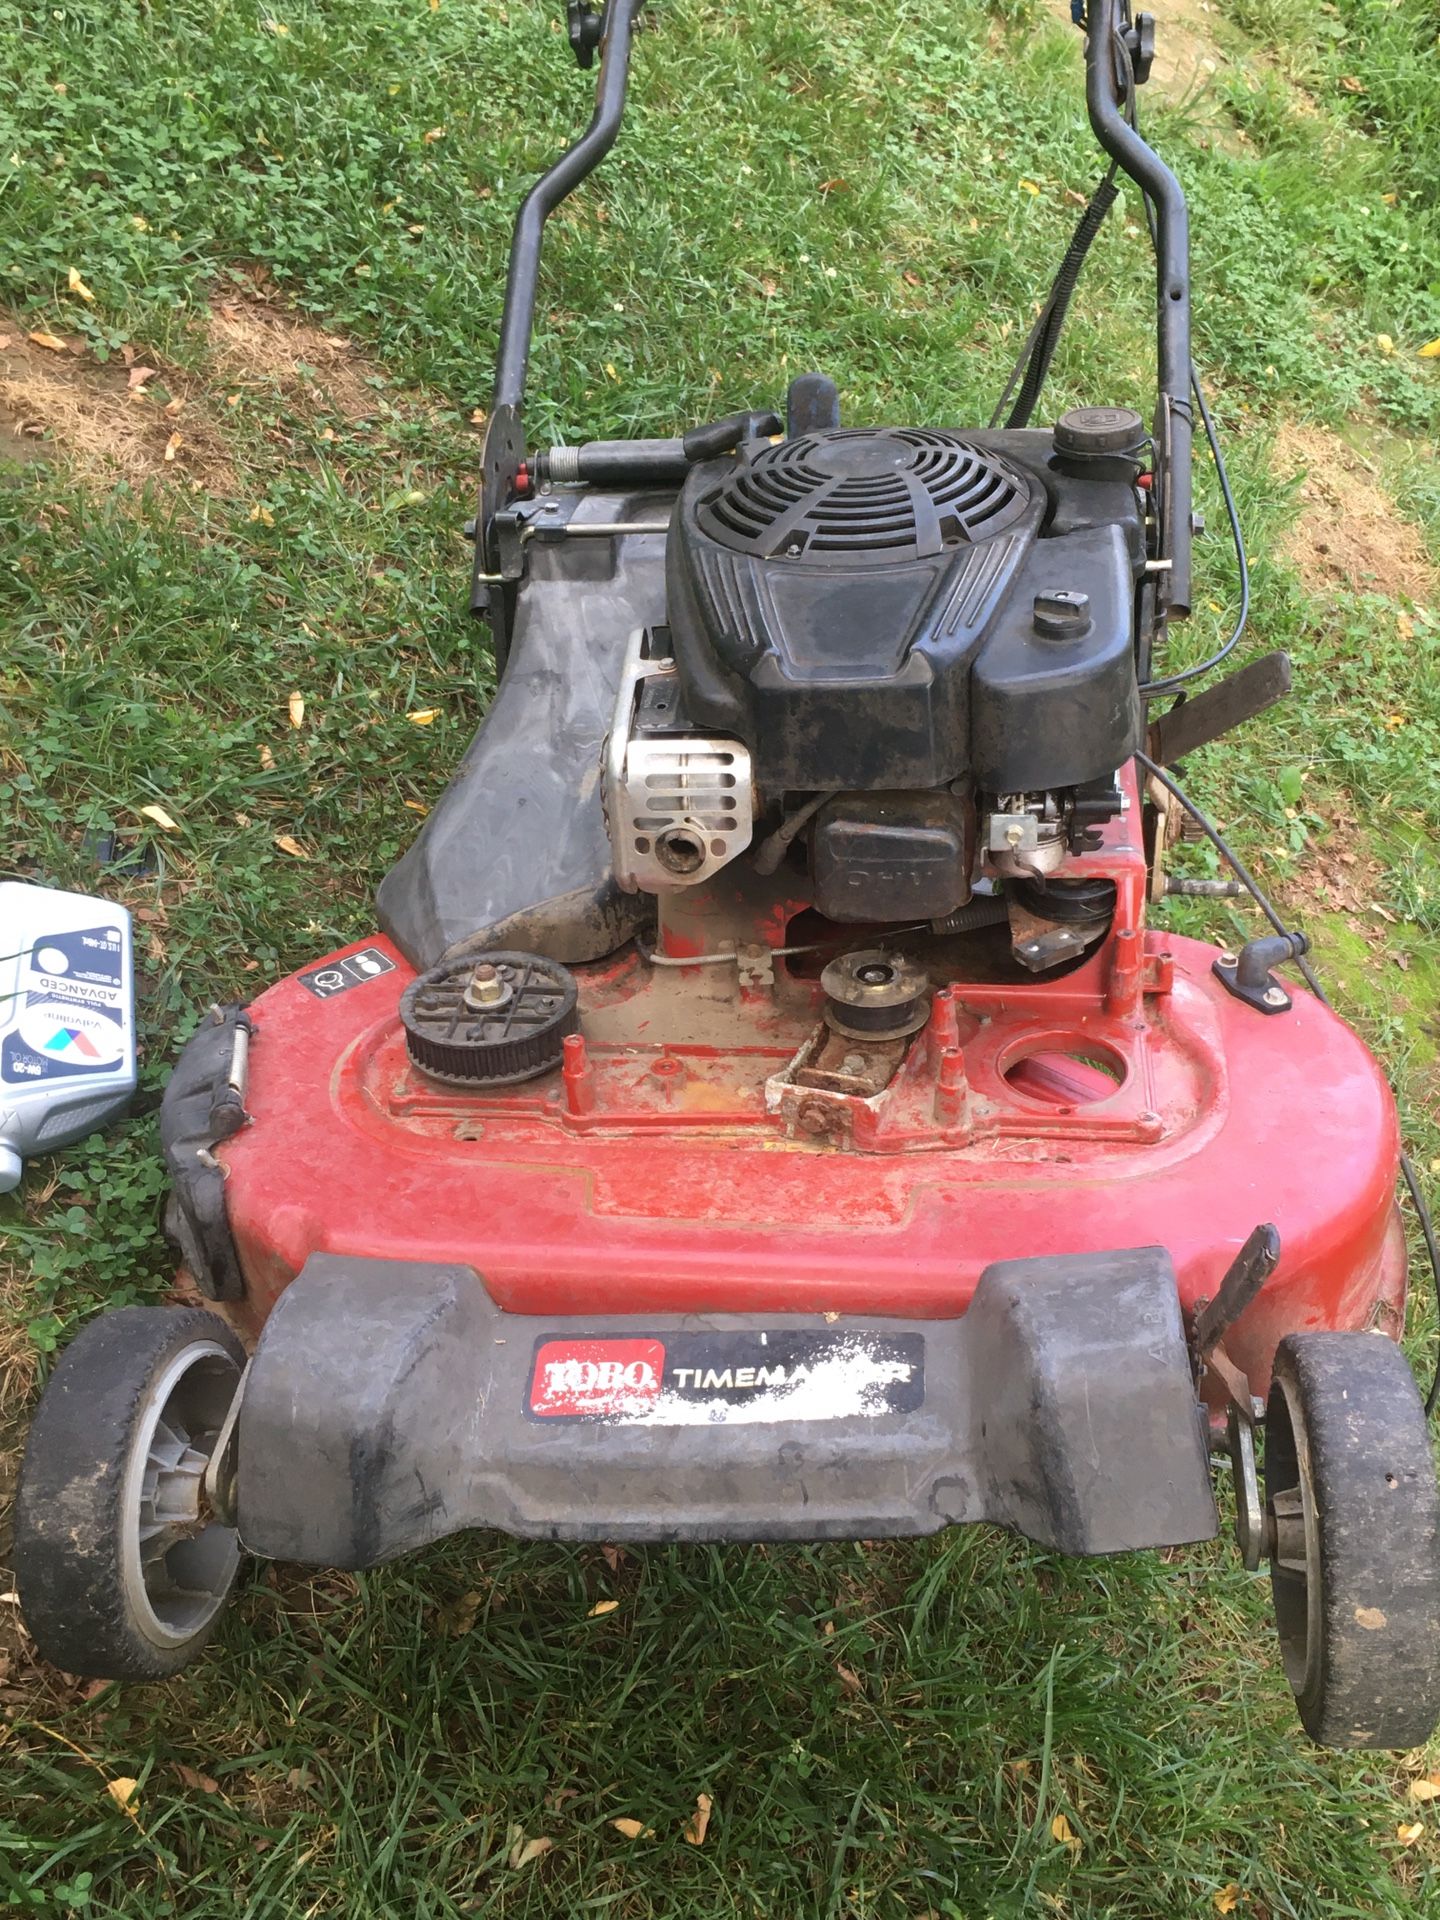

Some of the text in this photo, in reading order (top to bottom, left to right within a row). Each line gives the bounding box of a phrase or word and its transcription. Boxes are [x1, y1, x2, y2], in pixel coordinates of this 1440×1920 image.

[40, 978, 117, 1001] ADVANCED
[86, 1000, 102, 1008] FULL
[47, 1013, 102, 1029] Valvoline
[10, 1051, 49, 1066] MOTOR OIL
[13, 1062, 42, 1076] 5W-20
